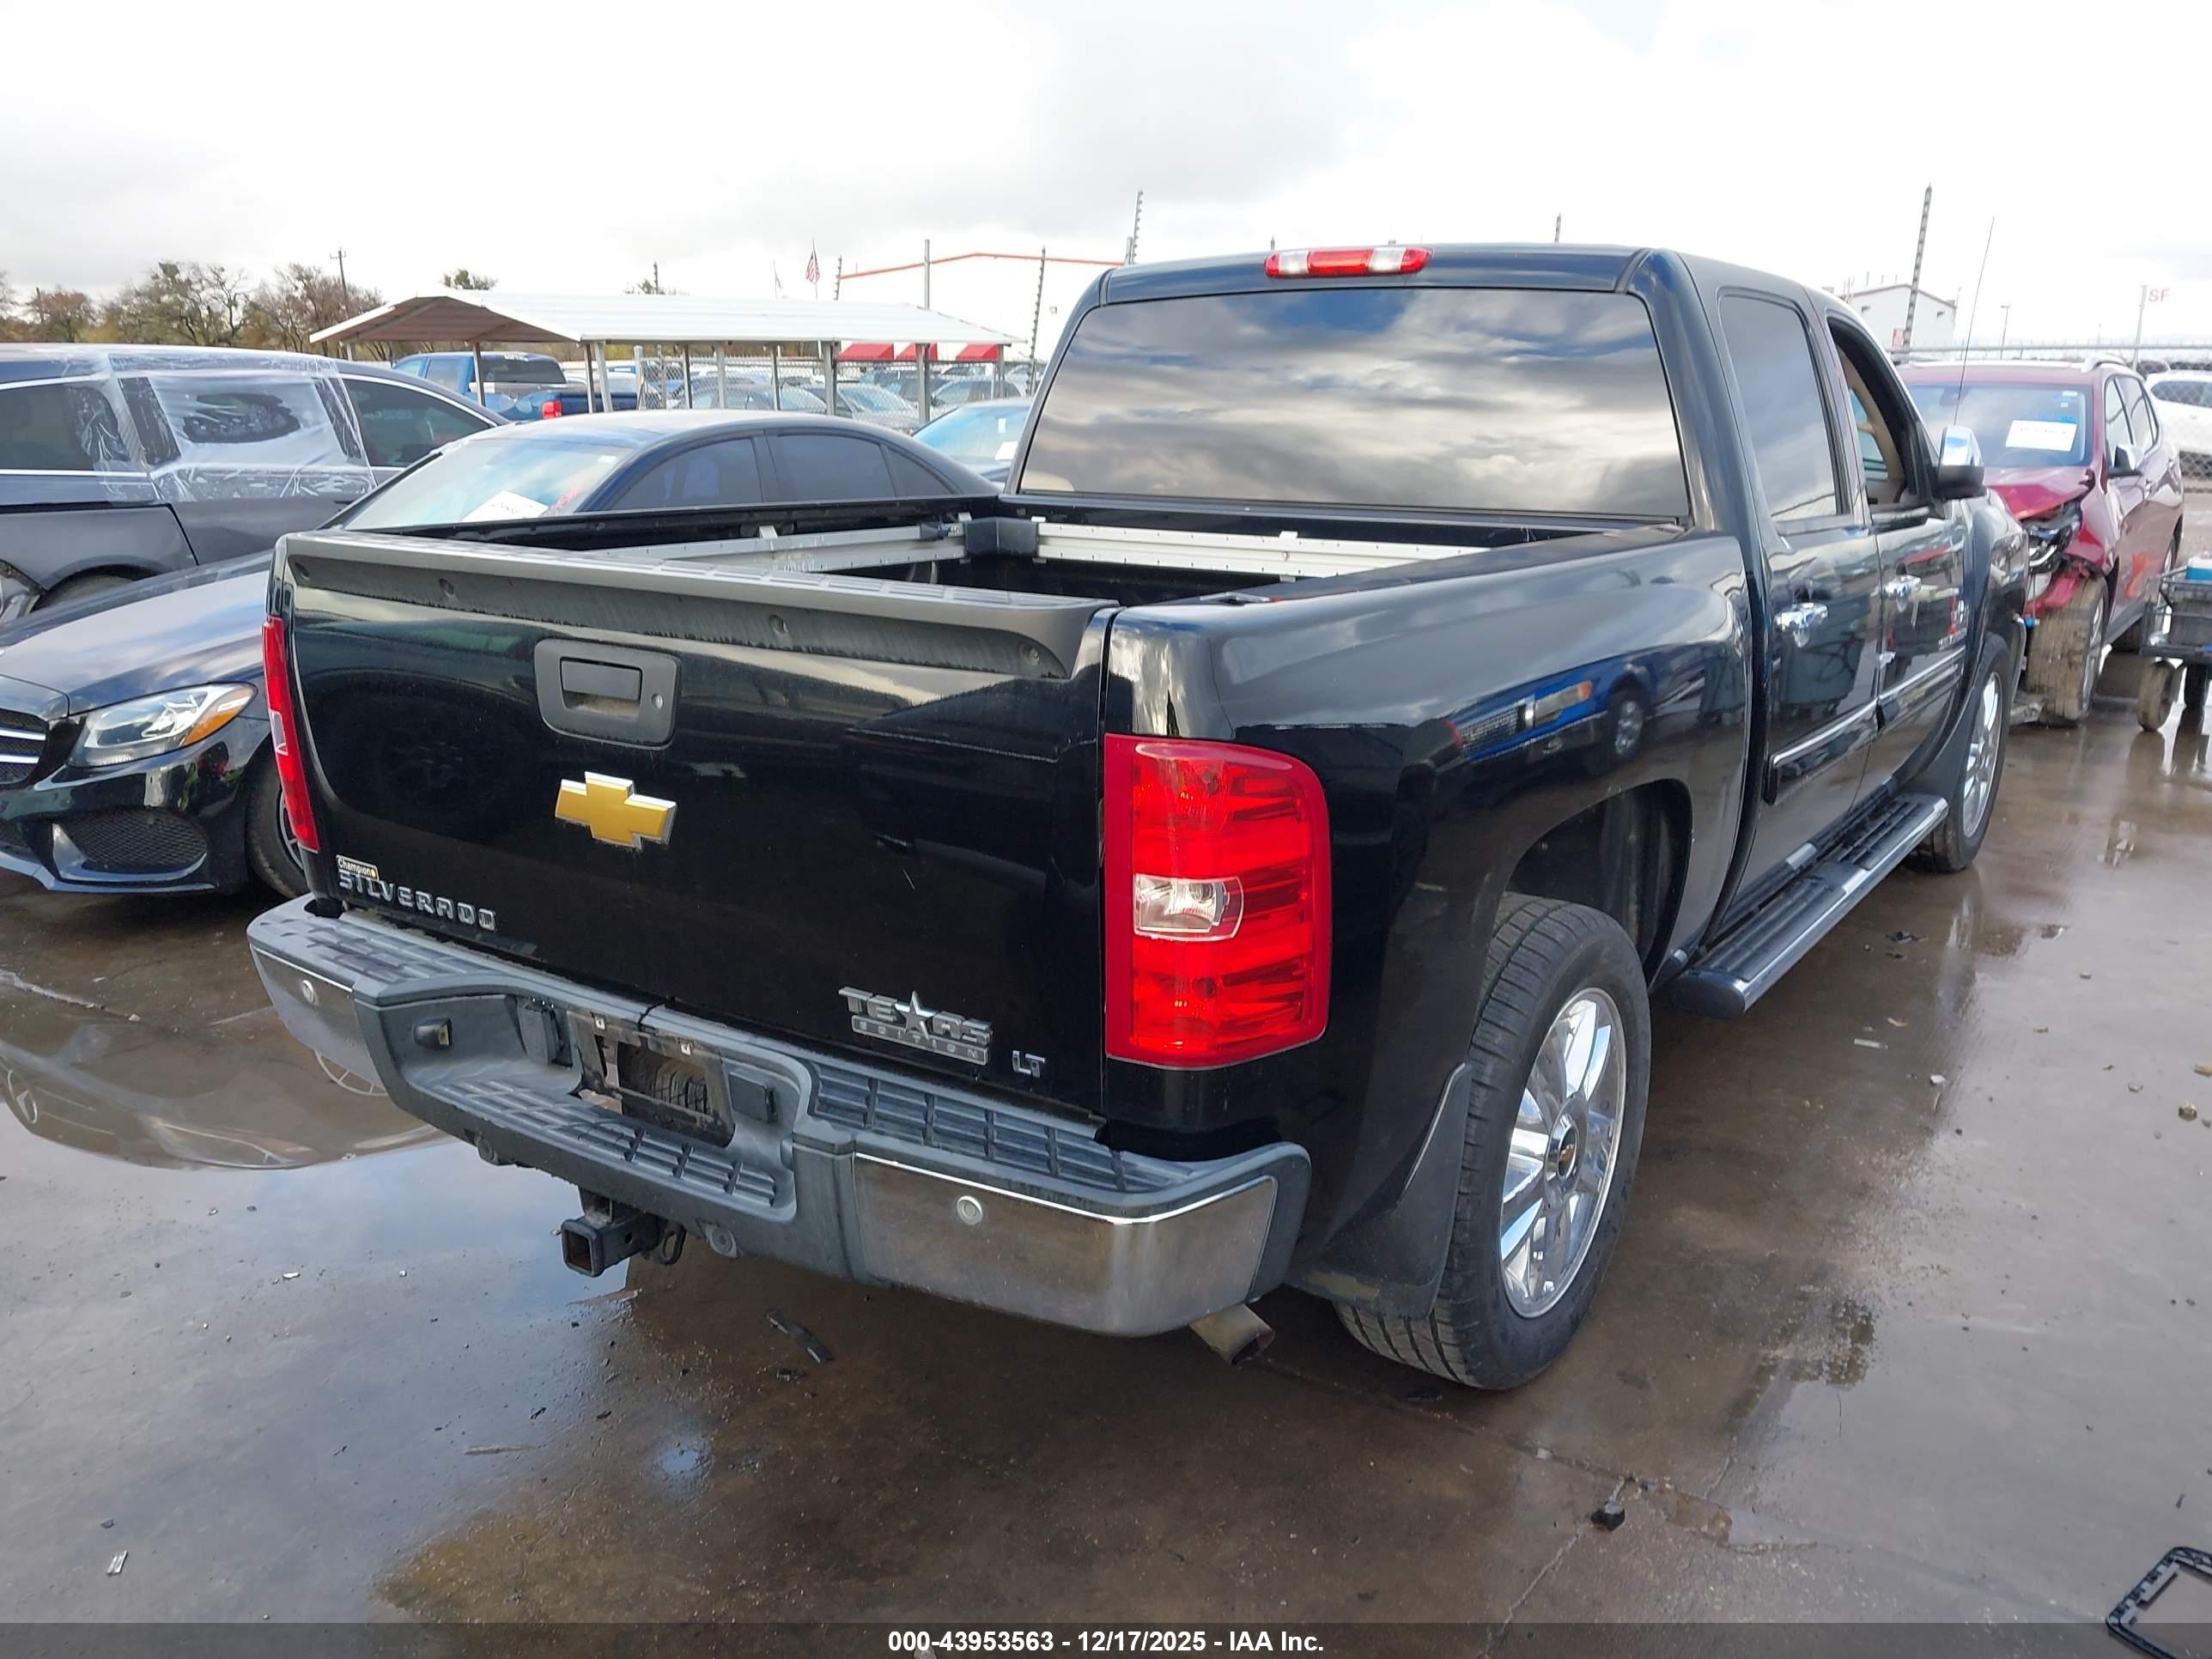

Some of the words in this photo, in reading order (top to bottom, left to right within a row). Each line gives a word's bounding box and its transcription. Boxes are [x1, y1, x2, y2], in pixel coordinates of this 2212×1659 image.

[337, 858, 372, 877] Champion
[338, 872, 496, 931] SILVERADO
[1012, 1049, 1046, 1078] LT
